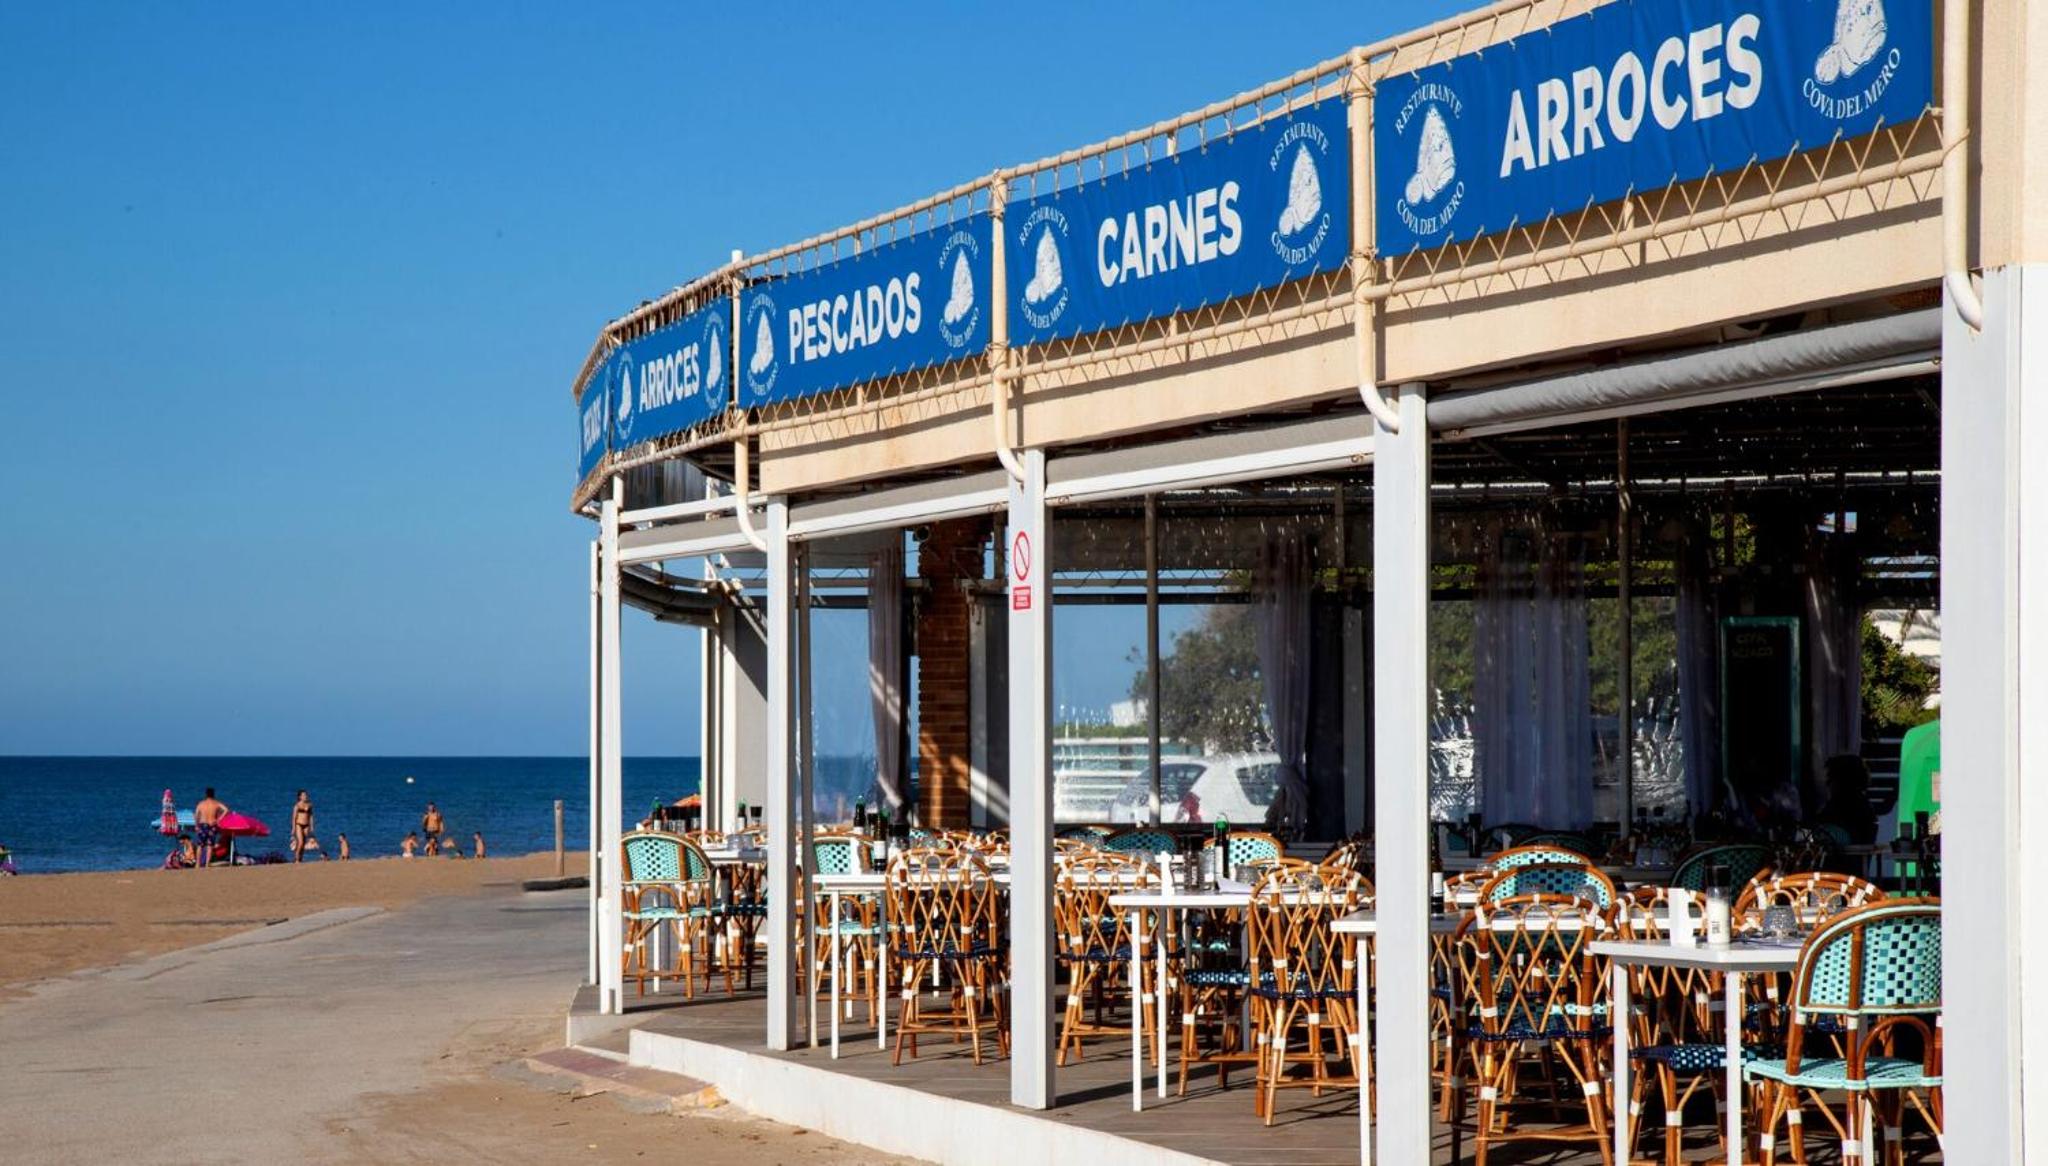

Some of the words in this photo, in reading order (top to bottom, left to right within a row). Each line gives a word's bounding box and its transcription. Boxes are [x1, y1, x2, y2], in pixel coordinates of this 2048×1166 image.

[1395, 83, 1463, 135] RESTAURANTE
[1499, 12, 1763, 178] ARROCES
[1803, 78, 1834, 119] COVA
[1836, 95, 1864, 119] DEL
[1863, 48, 1900, 110] MERO
[1269, 122, 1329, 171] RESTAURANTE
[1097, 180, 1242, 288] CARNES
[1271, 231, 1290, 264] COVA
[1291, 249, 1307, 265] DEL
[1308, 212, 1331, 258] MERO
[1397, 198, 1418, 234] COVA
[1420, 216, 1438, 235] DEL
[1439, 181, 1465, 229] MERO
[788, 271, 921, 365] PESCADOS
[639, 342, 700, 413] ARROCES
